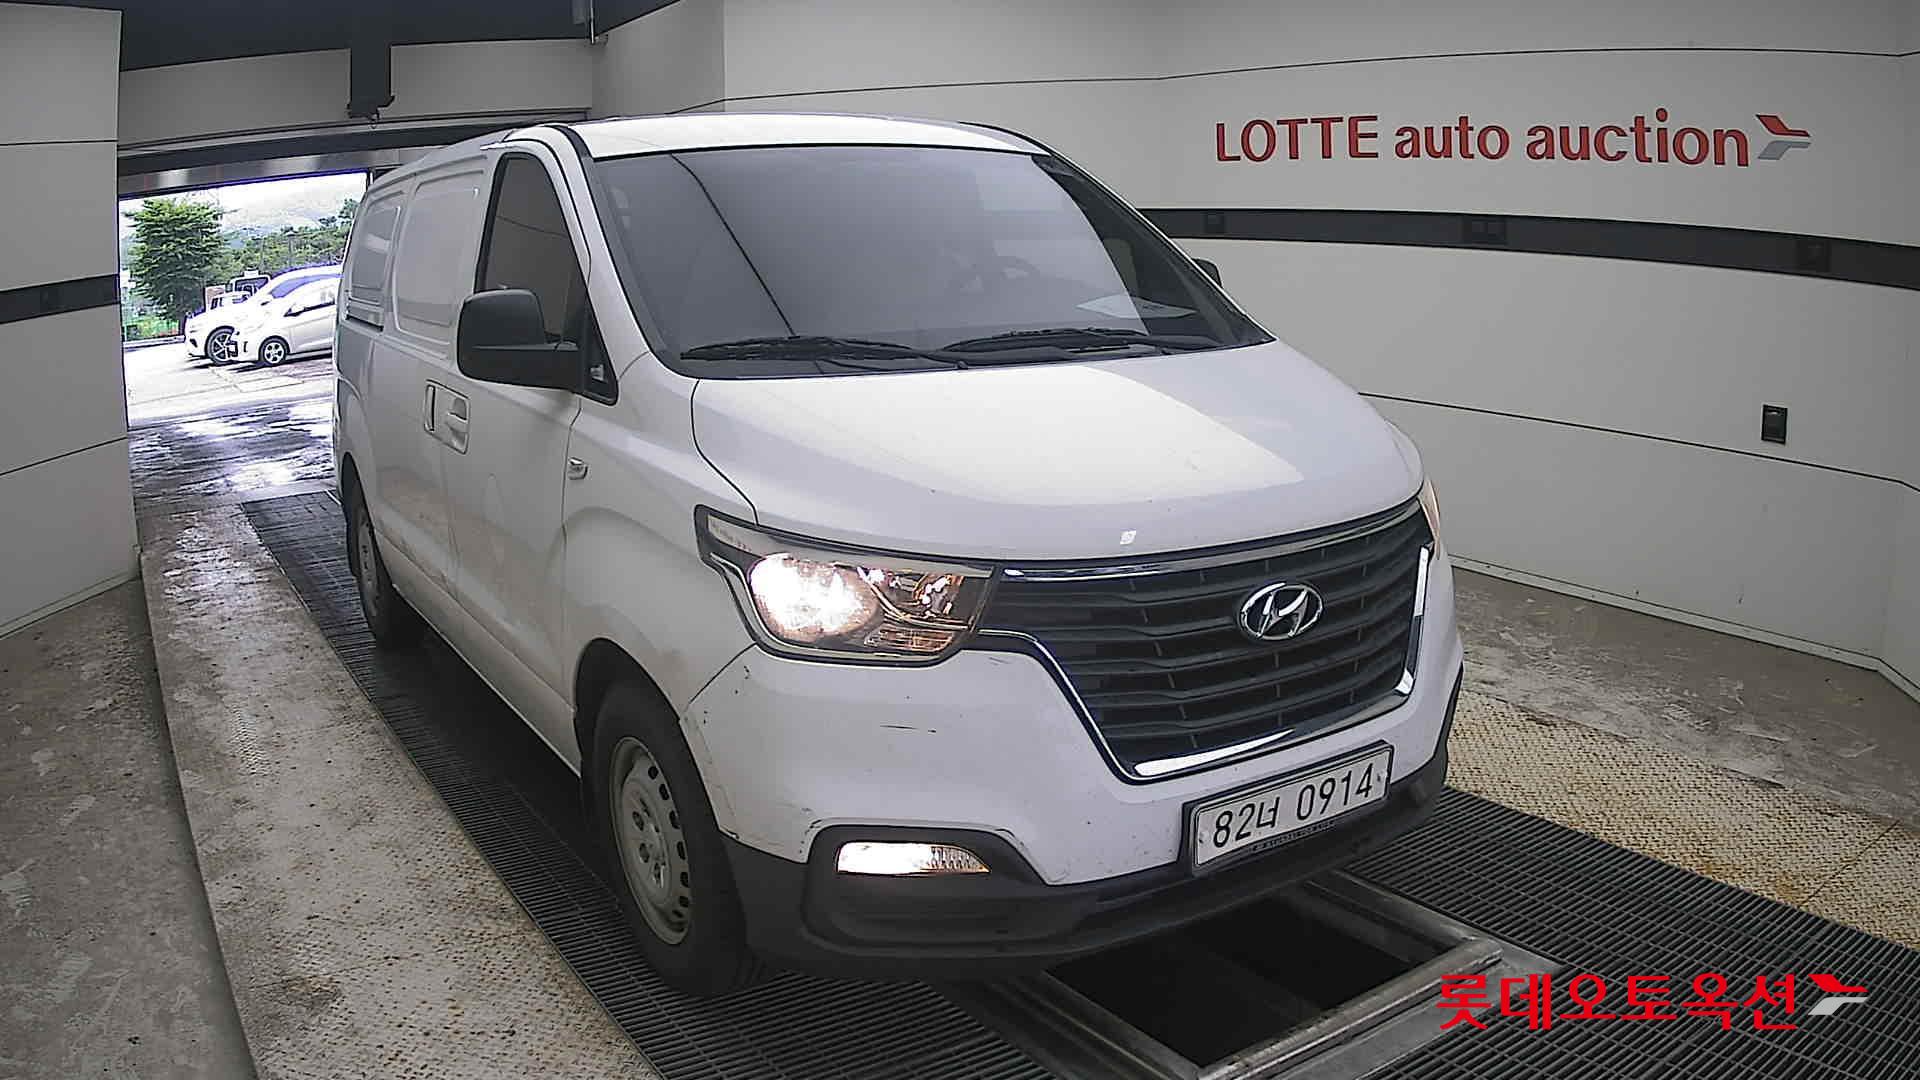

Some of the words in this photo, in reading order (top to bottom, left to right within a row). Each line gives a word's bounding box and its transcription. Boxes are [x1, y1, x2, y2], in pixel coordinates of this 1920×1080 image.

[1215, 115, 1379, 163] LOTTE
[1394, 116, 1511, 160] auto
[1525, 107, 1750, 167] auction
[1212, 796, 1281, 848] 82너
[1296, 762, 1374, 821] 0914
